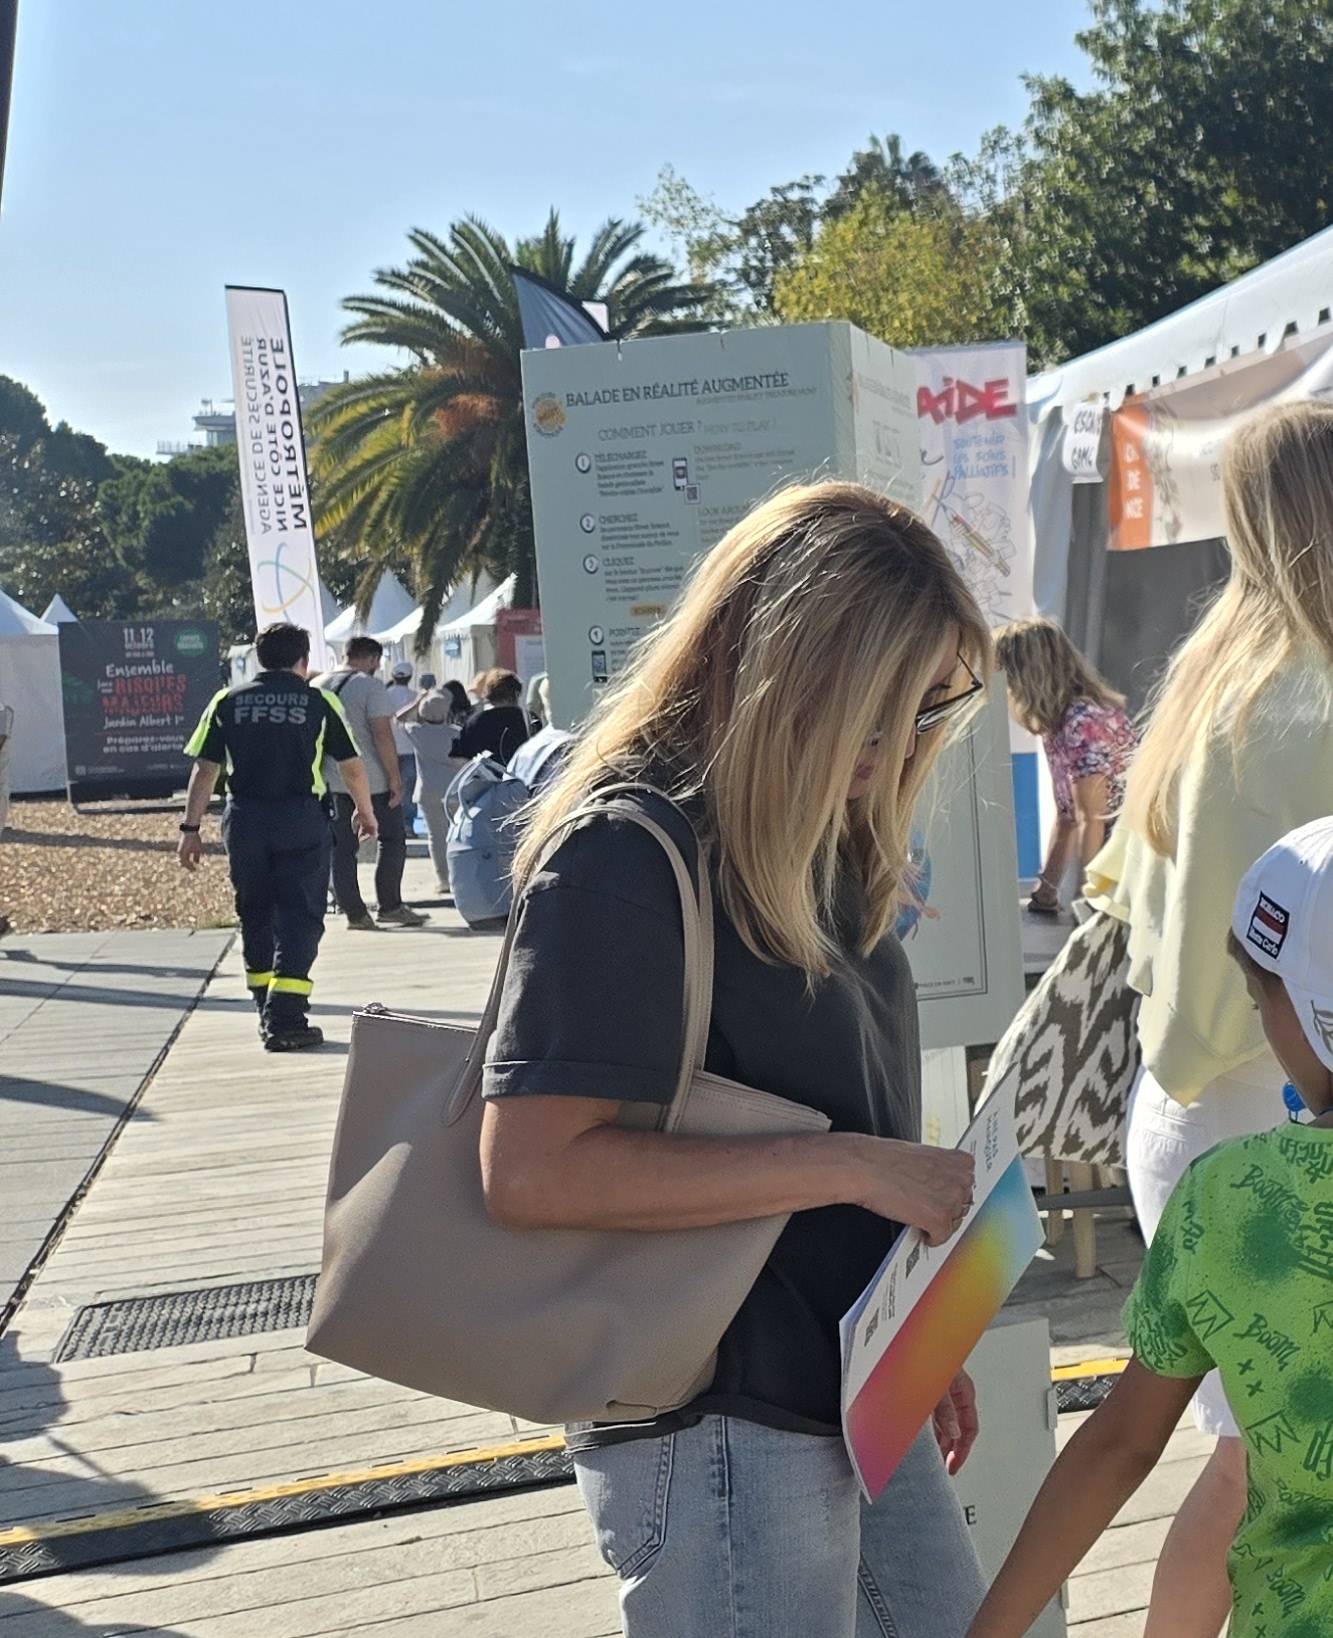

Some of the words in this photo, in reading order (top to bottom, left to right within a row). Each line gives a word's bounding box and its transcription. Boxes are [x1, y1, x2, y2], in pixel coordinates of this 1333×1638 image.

[566, 389, 623, 407] BALADE
[623, 388, 641, 402] EN
[643, 380, 699, 400] RÉALITÉ
[701, 373, 789, 396] AUGMENTÉE
[235, 693, 309, 706] SECOURS
[234, 706, 307, 724] FFSS
